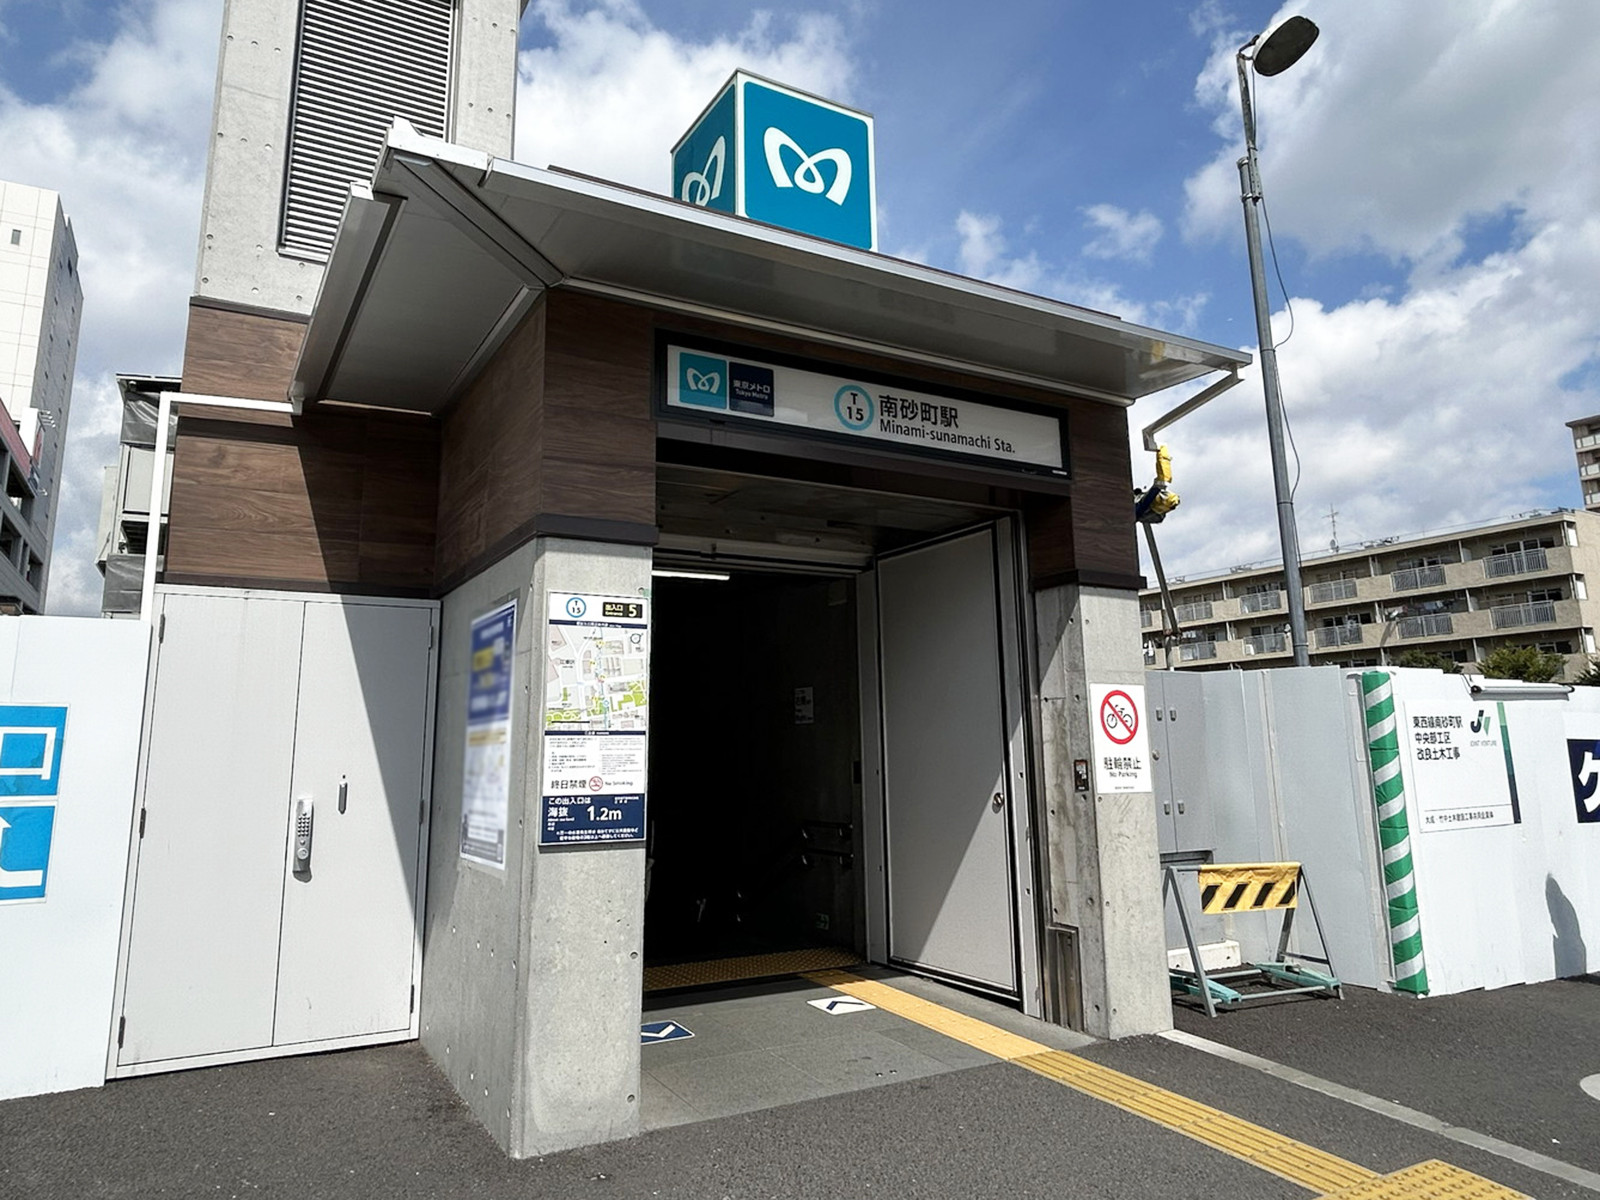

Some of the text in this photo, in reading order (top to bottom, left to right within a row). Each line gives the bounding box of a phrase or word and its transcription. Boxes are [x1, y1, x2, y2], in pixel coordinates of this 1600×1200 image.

[733, 380, 771, 393] 東京メトロ
[735, 388, 769, 400] Tokyo Metro
[850, 392, 858, 404] T
[847, 406, 864, 421] 15
[879, 394, 959, 429] 南砂町駅
[880, 419, 1016, 453] Minami-sunamachi Sta.
[628, 604, 637, 617] 5
[1415, 731, 1452, 744] 中央部工区
[1416, 746, 1460, 761] 改良土木工事
[1104, 757, 1142, 770] 駐輪禁止
[1118, 771, 1138, 779] Parking
[551, 779, 587, 789] 終日禁煙
[587, 805, 622, 821] 1.2m
